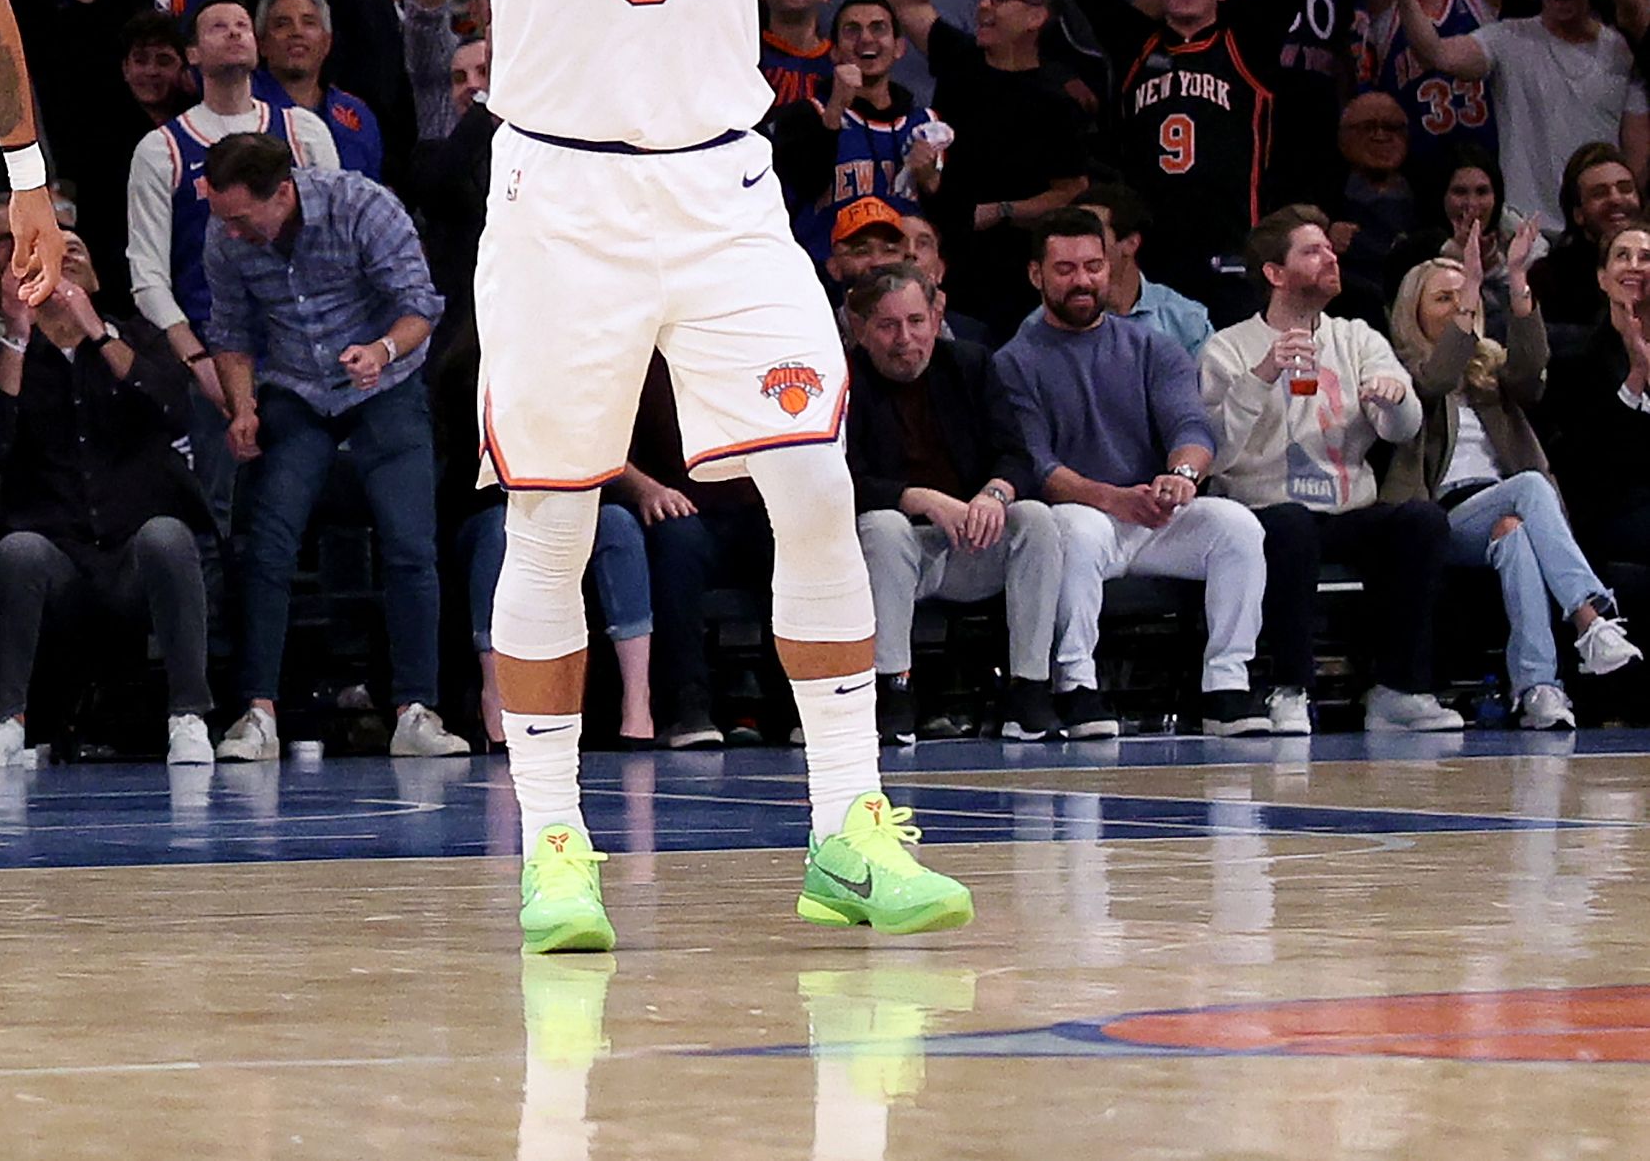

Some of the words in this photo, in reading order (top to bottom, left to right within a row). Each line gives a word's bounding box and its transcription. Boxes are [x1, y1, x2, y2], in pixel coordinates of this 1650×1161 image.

[1134, 70, 1174, 116] NEW
[1177, 69, 1231, 112] YORK
[1416, 77, 1489, 135] 33
[1158, 112, 1196, 175] 9
[834, 158, 875, 202] EW
[761, 366, 824, 392] KNICKS
[1292, 476, 1333, 498] NBA
